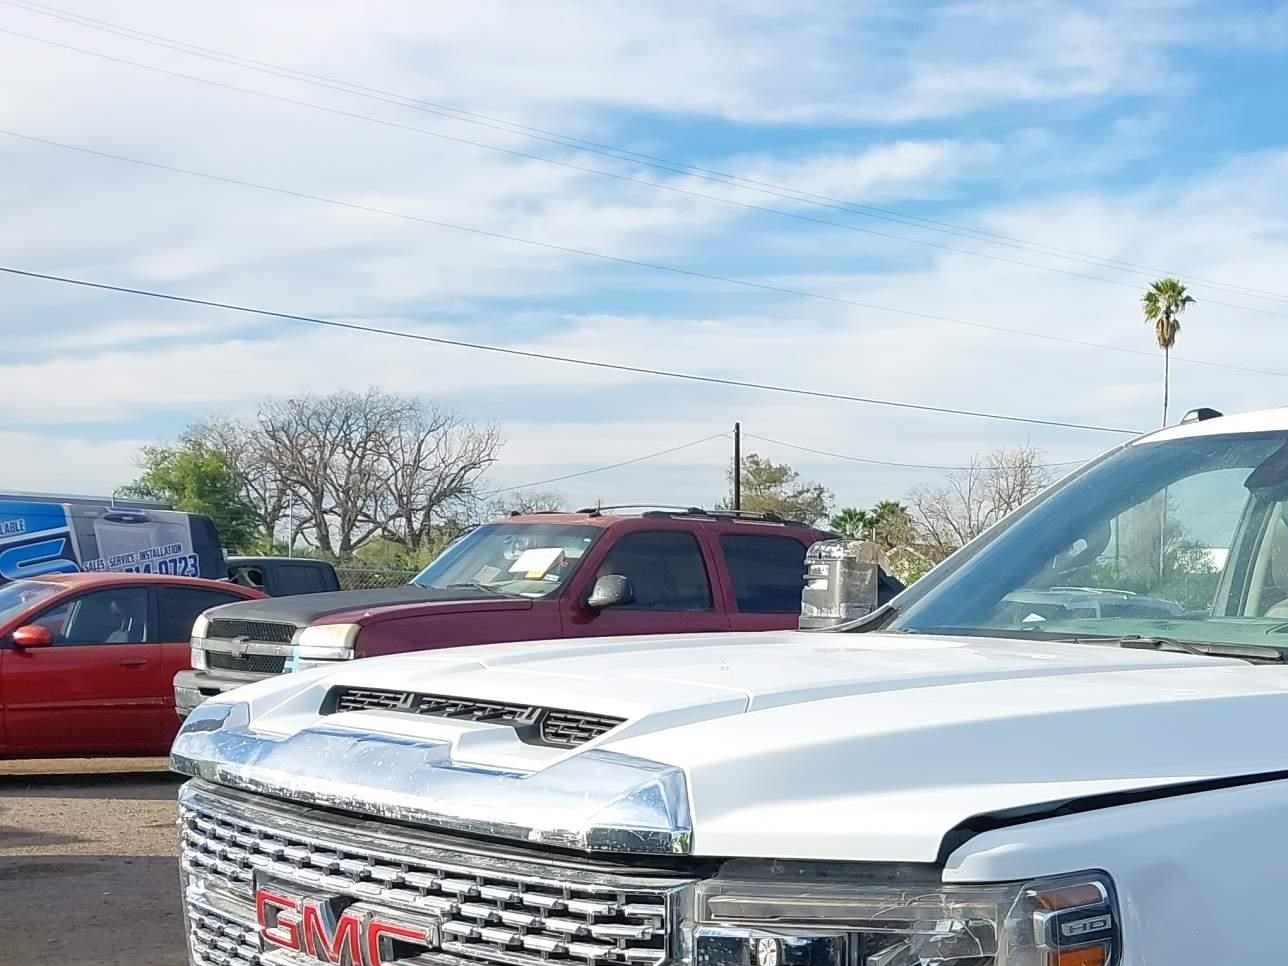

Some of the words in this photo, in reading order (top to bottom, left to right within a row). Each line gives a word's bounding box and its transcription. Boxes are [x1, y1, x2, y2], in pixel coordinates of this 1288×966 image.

[84, 559, 105, 571] SALES
[109, 553, 136, 567] SERVICE
[139, 543, 182, 561] INSTALLATION
